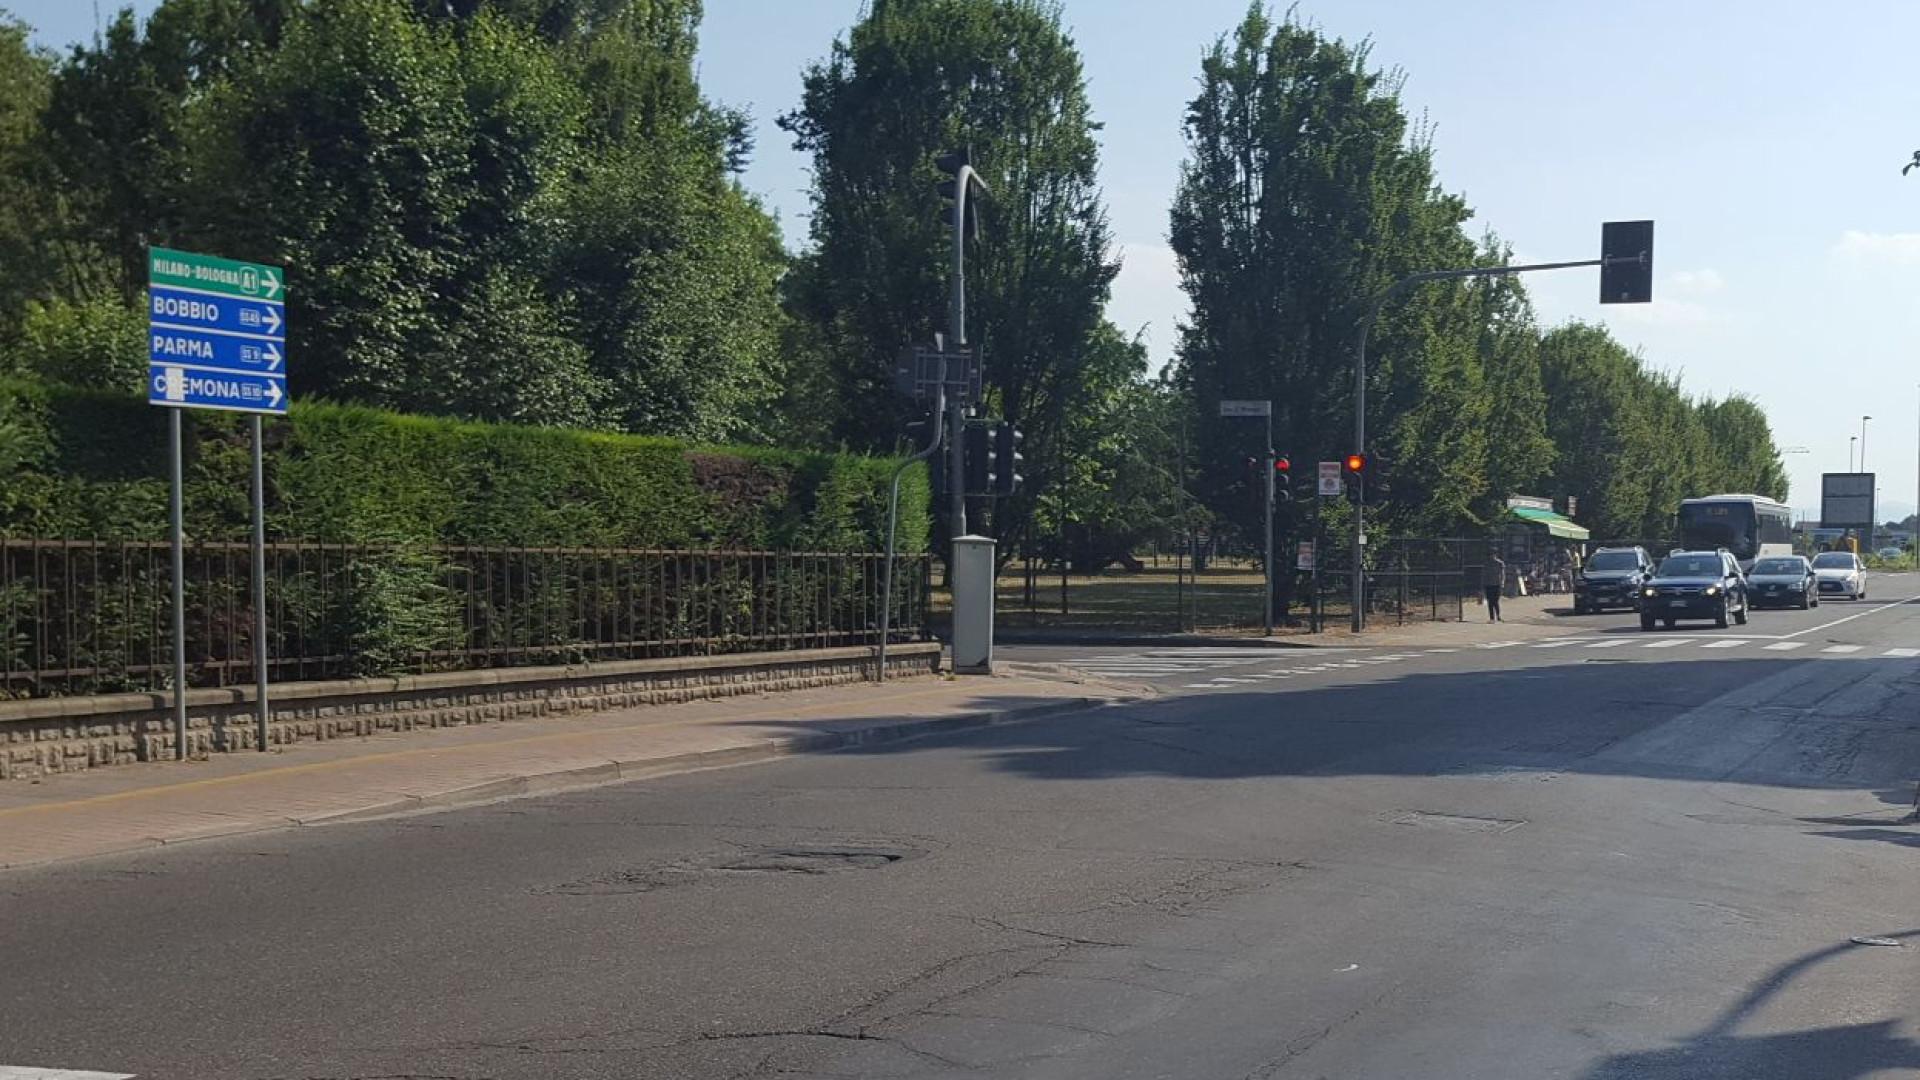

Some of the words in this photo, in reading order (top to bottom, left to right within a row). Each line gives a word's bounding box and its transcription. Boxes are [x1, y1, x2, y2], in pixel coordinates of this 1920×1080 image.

[243, 272, 256, 290] A1
[153, 296, 219, 322] BOBBIO
[153, 336, 214, 359] PARMA
[153, 375, 241, 399] CEMONA
